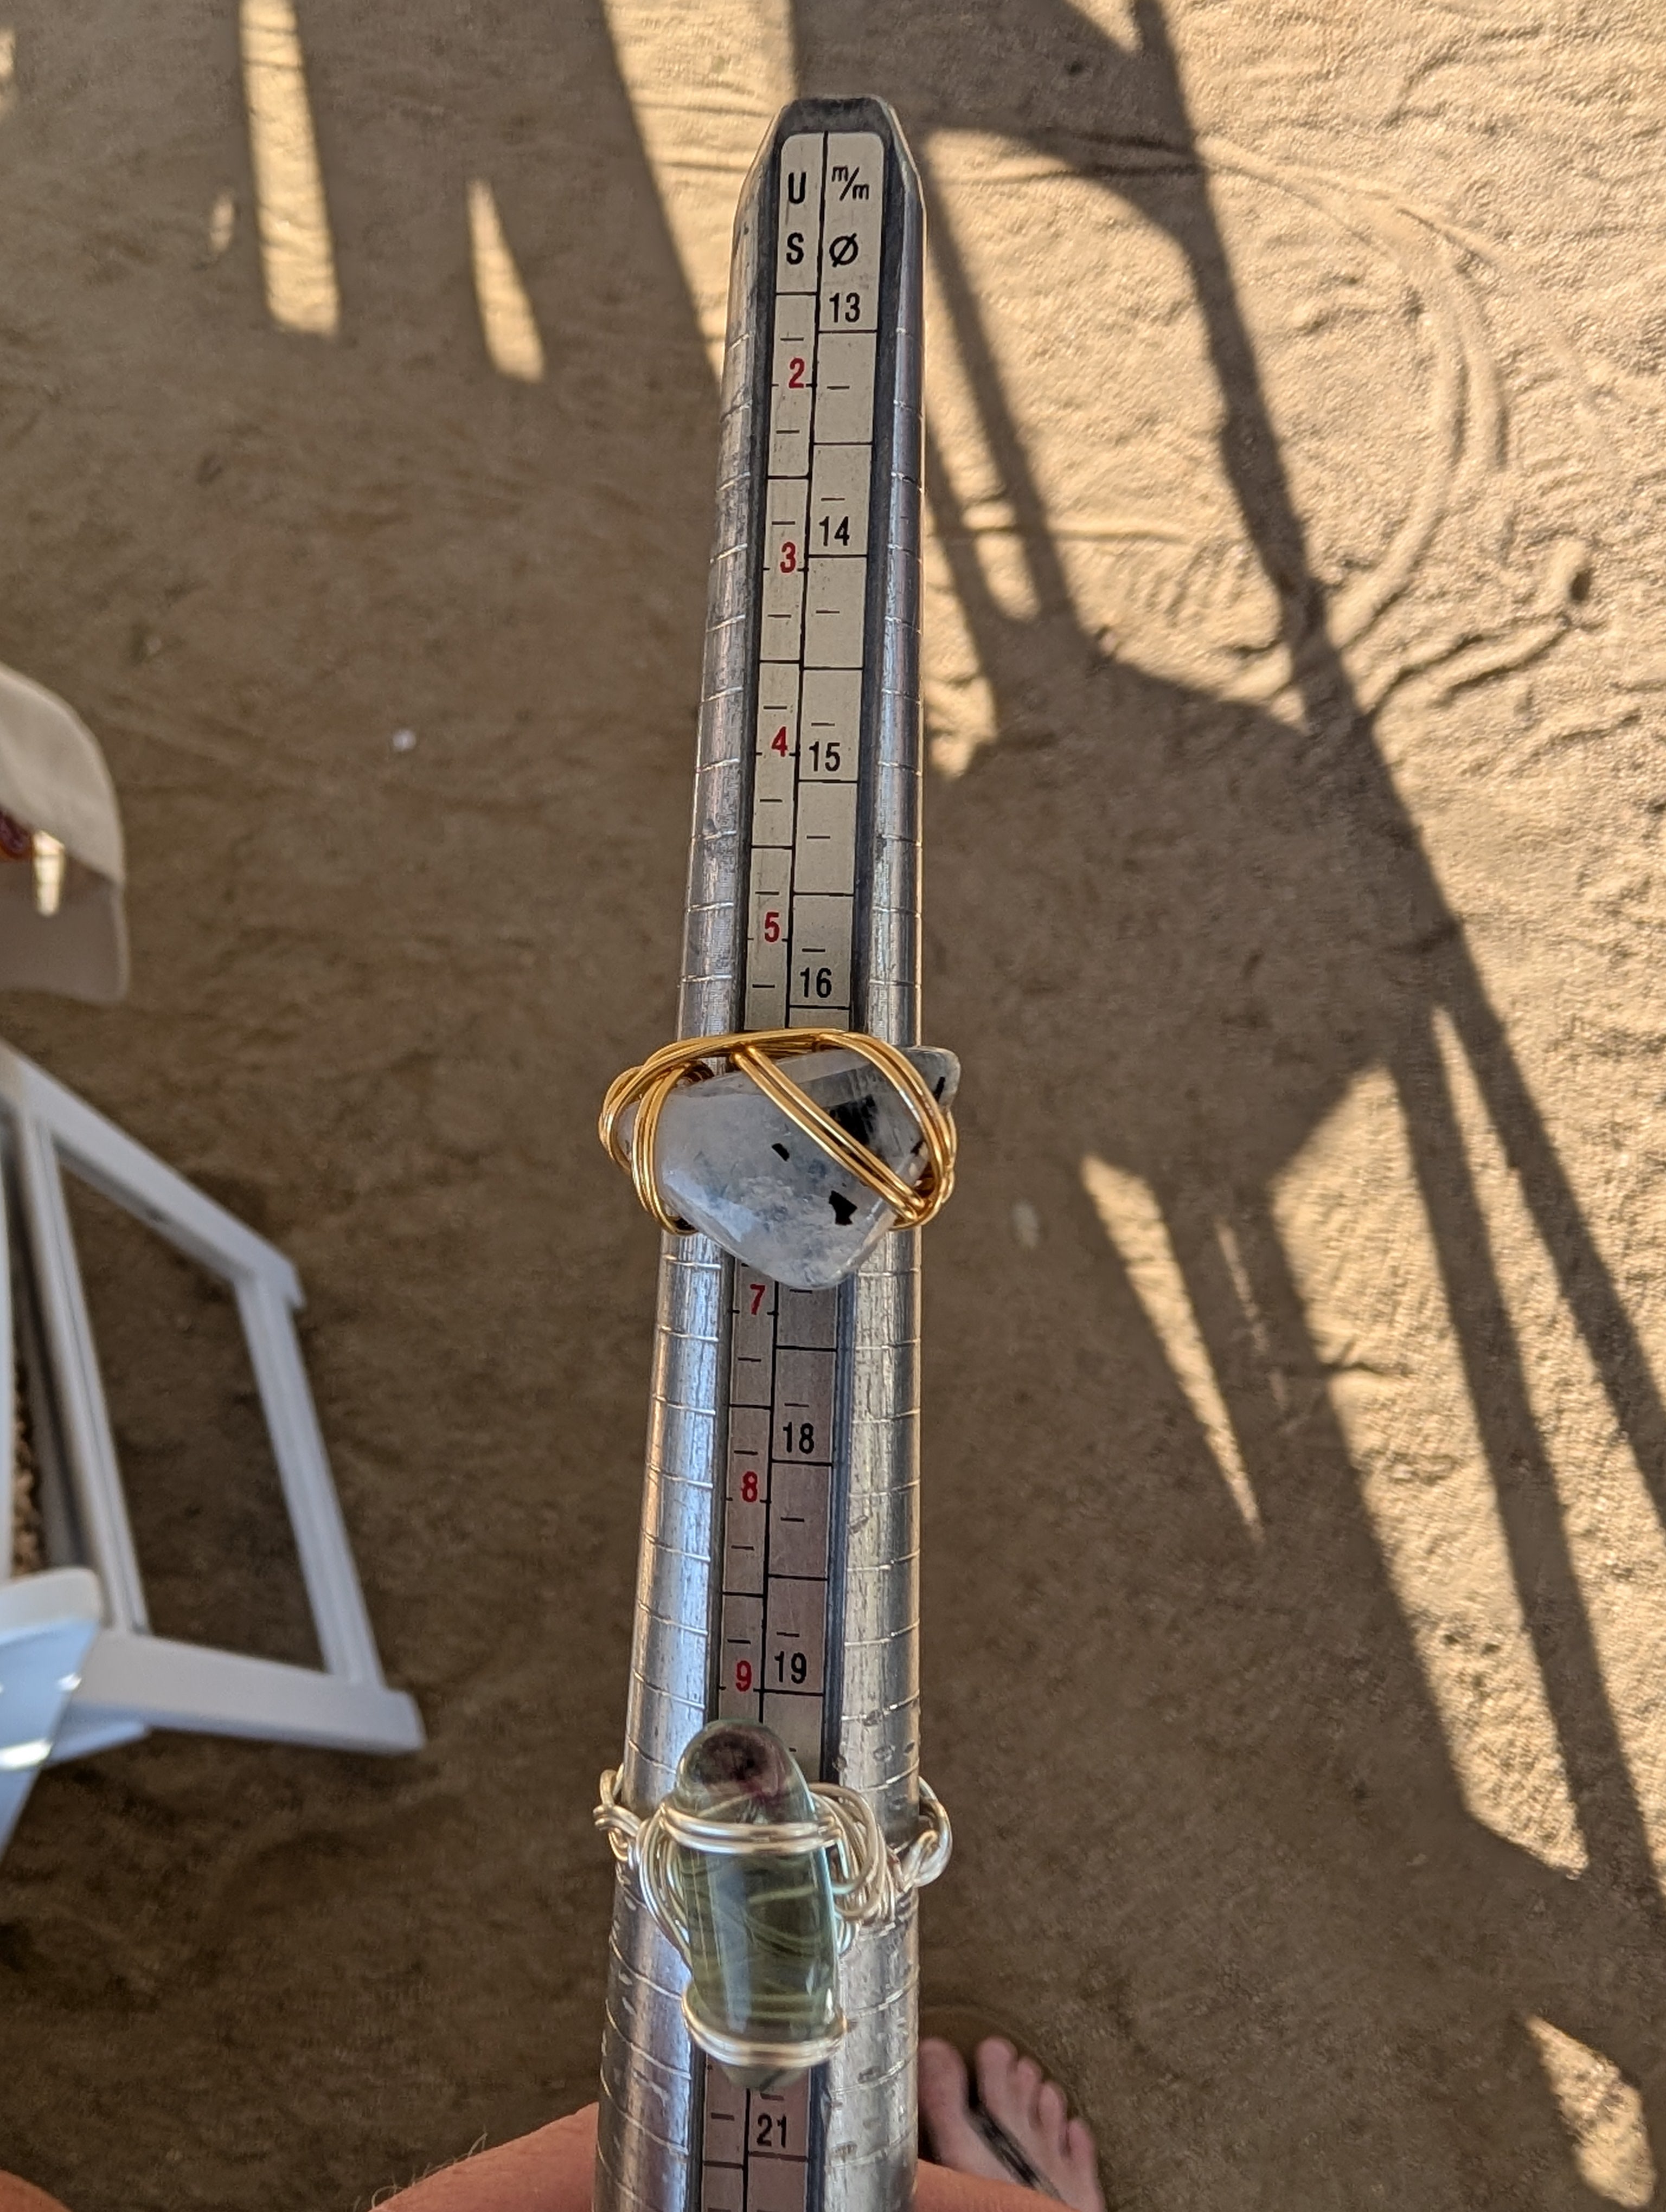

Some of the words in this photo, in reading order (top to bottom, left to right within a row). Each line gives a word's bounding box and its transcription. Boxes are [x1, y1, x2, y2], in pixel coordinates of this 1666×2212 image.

[829, 293, 860, 323] 13
[789, 358, 805, 389] 2
[819, 516, 850, 546] 14
[780, 542, 796, 573] 3
[771, 726, 788, 757] 4
[809, 741, 841, 772] 15
[764, 911, 780, 942] 5
[800, 967, 832, 998] 16
[749, 1284, 765, 1315] 7
[783, 1422, 814, 1454] 18
[741, 1471, 758, 1503] 8
[735, 1660, 752, 1692] 9
[774, 1650, 807, 1684] 19
[756, 2113, 786, 2148] 21
